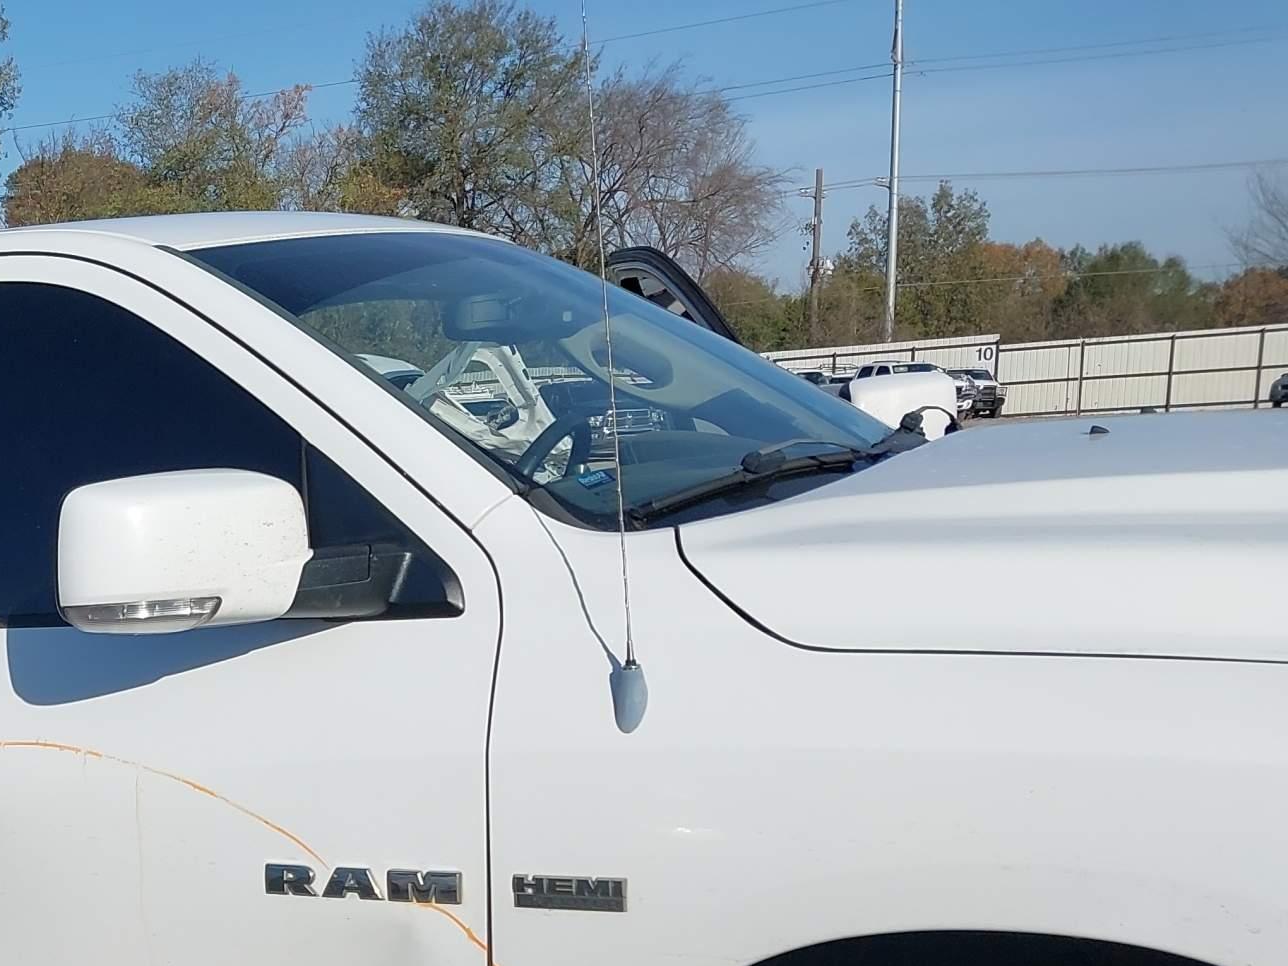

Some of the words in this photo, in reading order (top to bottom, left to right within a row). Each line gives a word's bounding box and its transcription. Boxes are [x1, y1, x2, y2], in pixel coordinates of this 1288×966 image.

[975, 346, 994, 361] 10
[264, 863, 463, 905] RAM
[512, 873, 628, 899] HEMI
